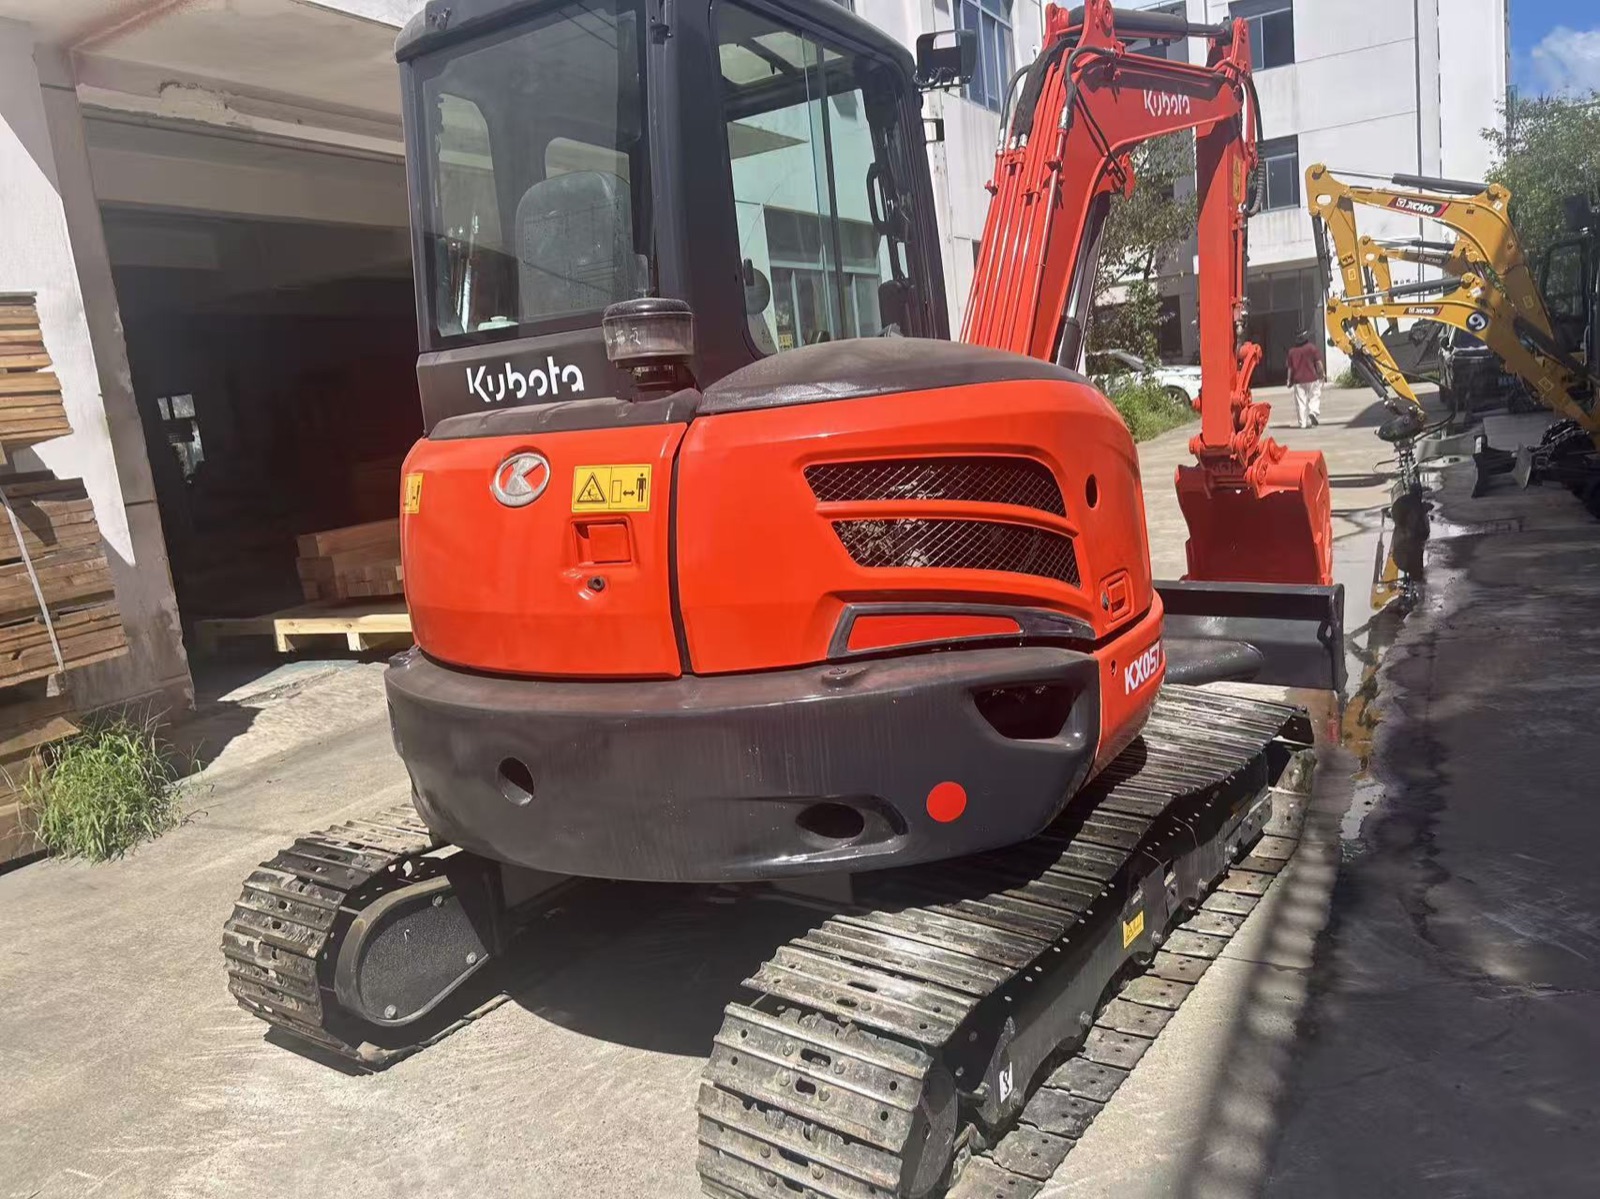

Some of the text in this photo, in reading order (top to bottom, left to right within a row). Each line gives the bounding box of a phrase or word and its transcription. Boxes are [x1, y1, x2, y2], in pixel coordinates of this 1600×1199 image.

[1143, 89, 1190, 117] Kubota
[1405, 200, 1435, 214] XCMG
[1468, 313, 1486, 330] 9
[466, 356, 585, 403] Kubota
[1124, 640, 1160, 695] KX057
